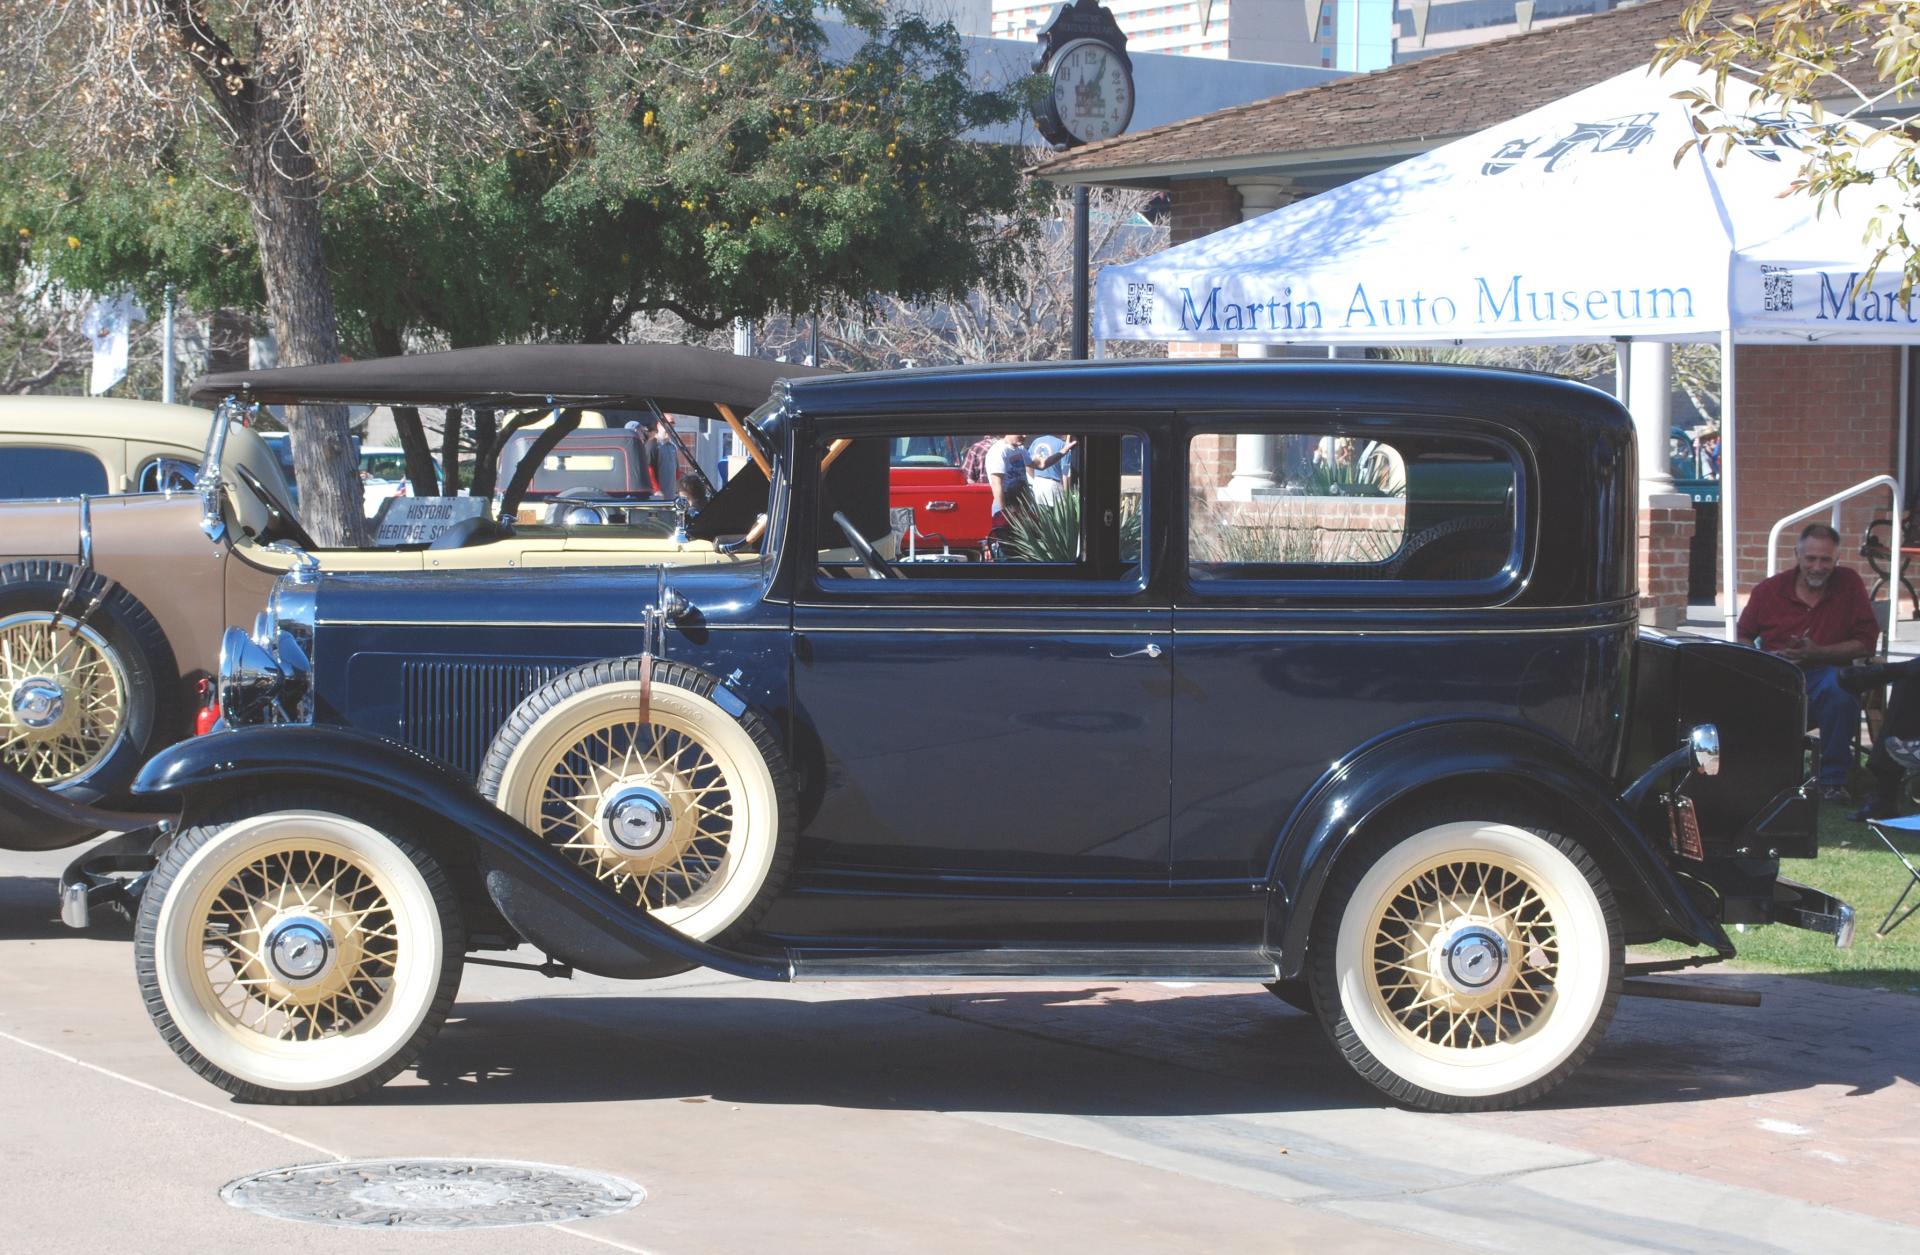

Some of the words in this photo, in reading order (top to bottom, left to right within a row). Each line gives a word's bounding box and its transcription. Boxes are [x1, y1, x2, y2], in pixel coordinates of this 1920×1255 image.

[1178, 286, 1323, 331] Martin
[1339, 282, 1456, 328] Auto
[1473, 275, 1696, 324] Museum
[1816, 271, 1920, 323] Mart
[406, 505, 453, 519] HISTORIC
[378, 525, 426, 540] HERITAGE
